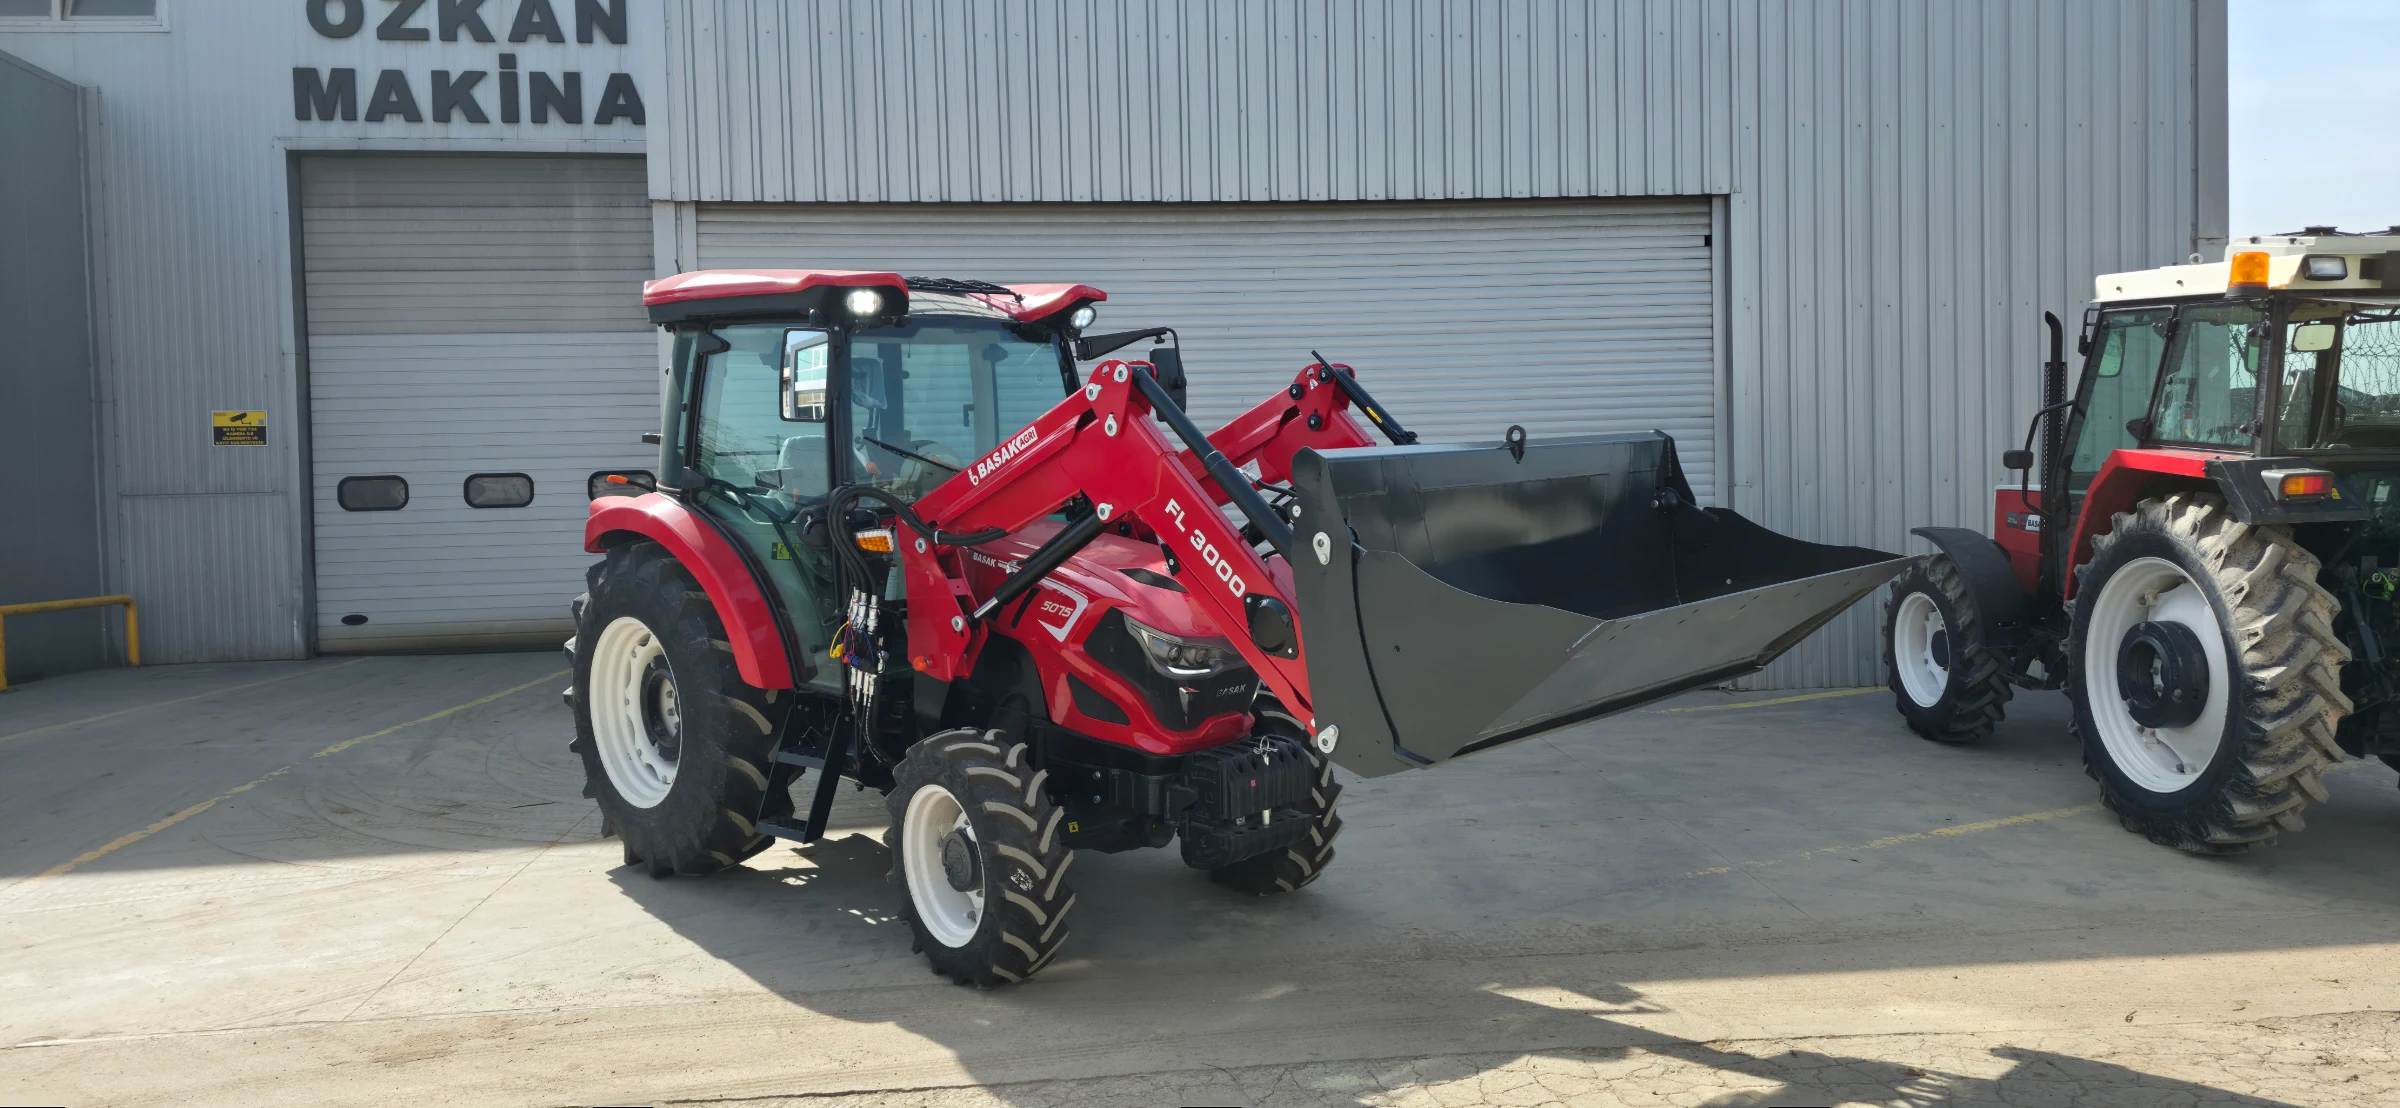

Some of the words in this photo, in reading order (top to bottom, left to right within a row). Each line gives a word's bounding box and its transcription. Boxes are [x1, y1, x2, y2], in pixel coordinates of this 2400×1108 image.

[293, 53, 647, 125] MAKİNA
[976, 438, 1020, 480] BASAK
[1018, 428, 1037, 448] AGRI
[972, 551, 997, 568] BASAK
[1164, 498, 1186, 533] FL
[1189, 528, 1246, 598] 3000
[1040, 600, 1074, 618] 5075
